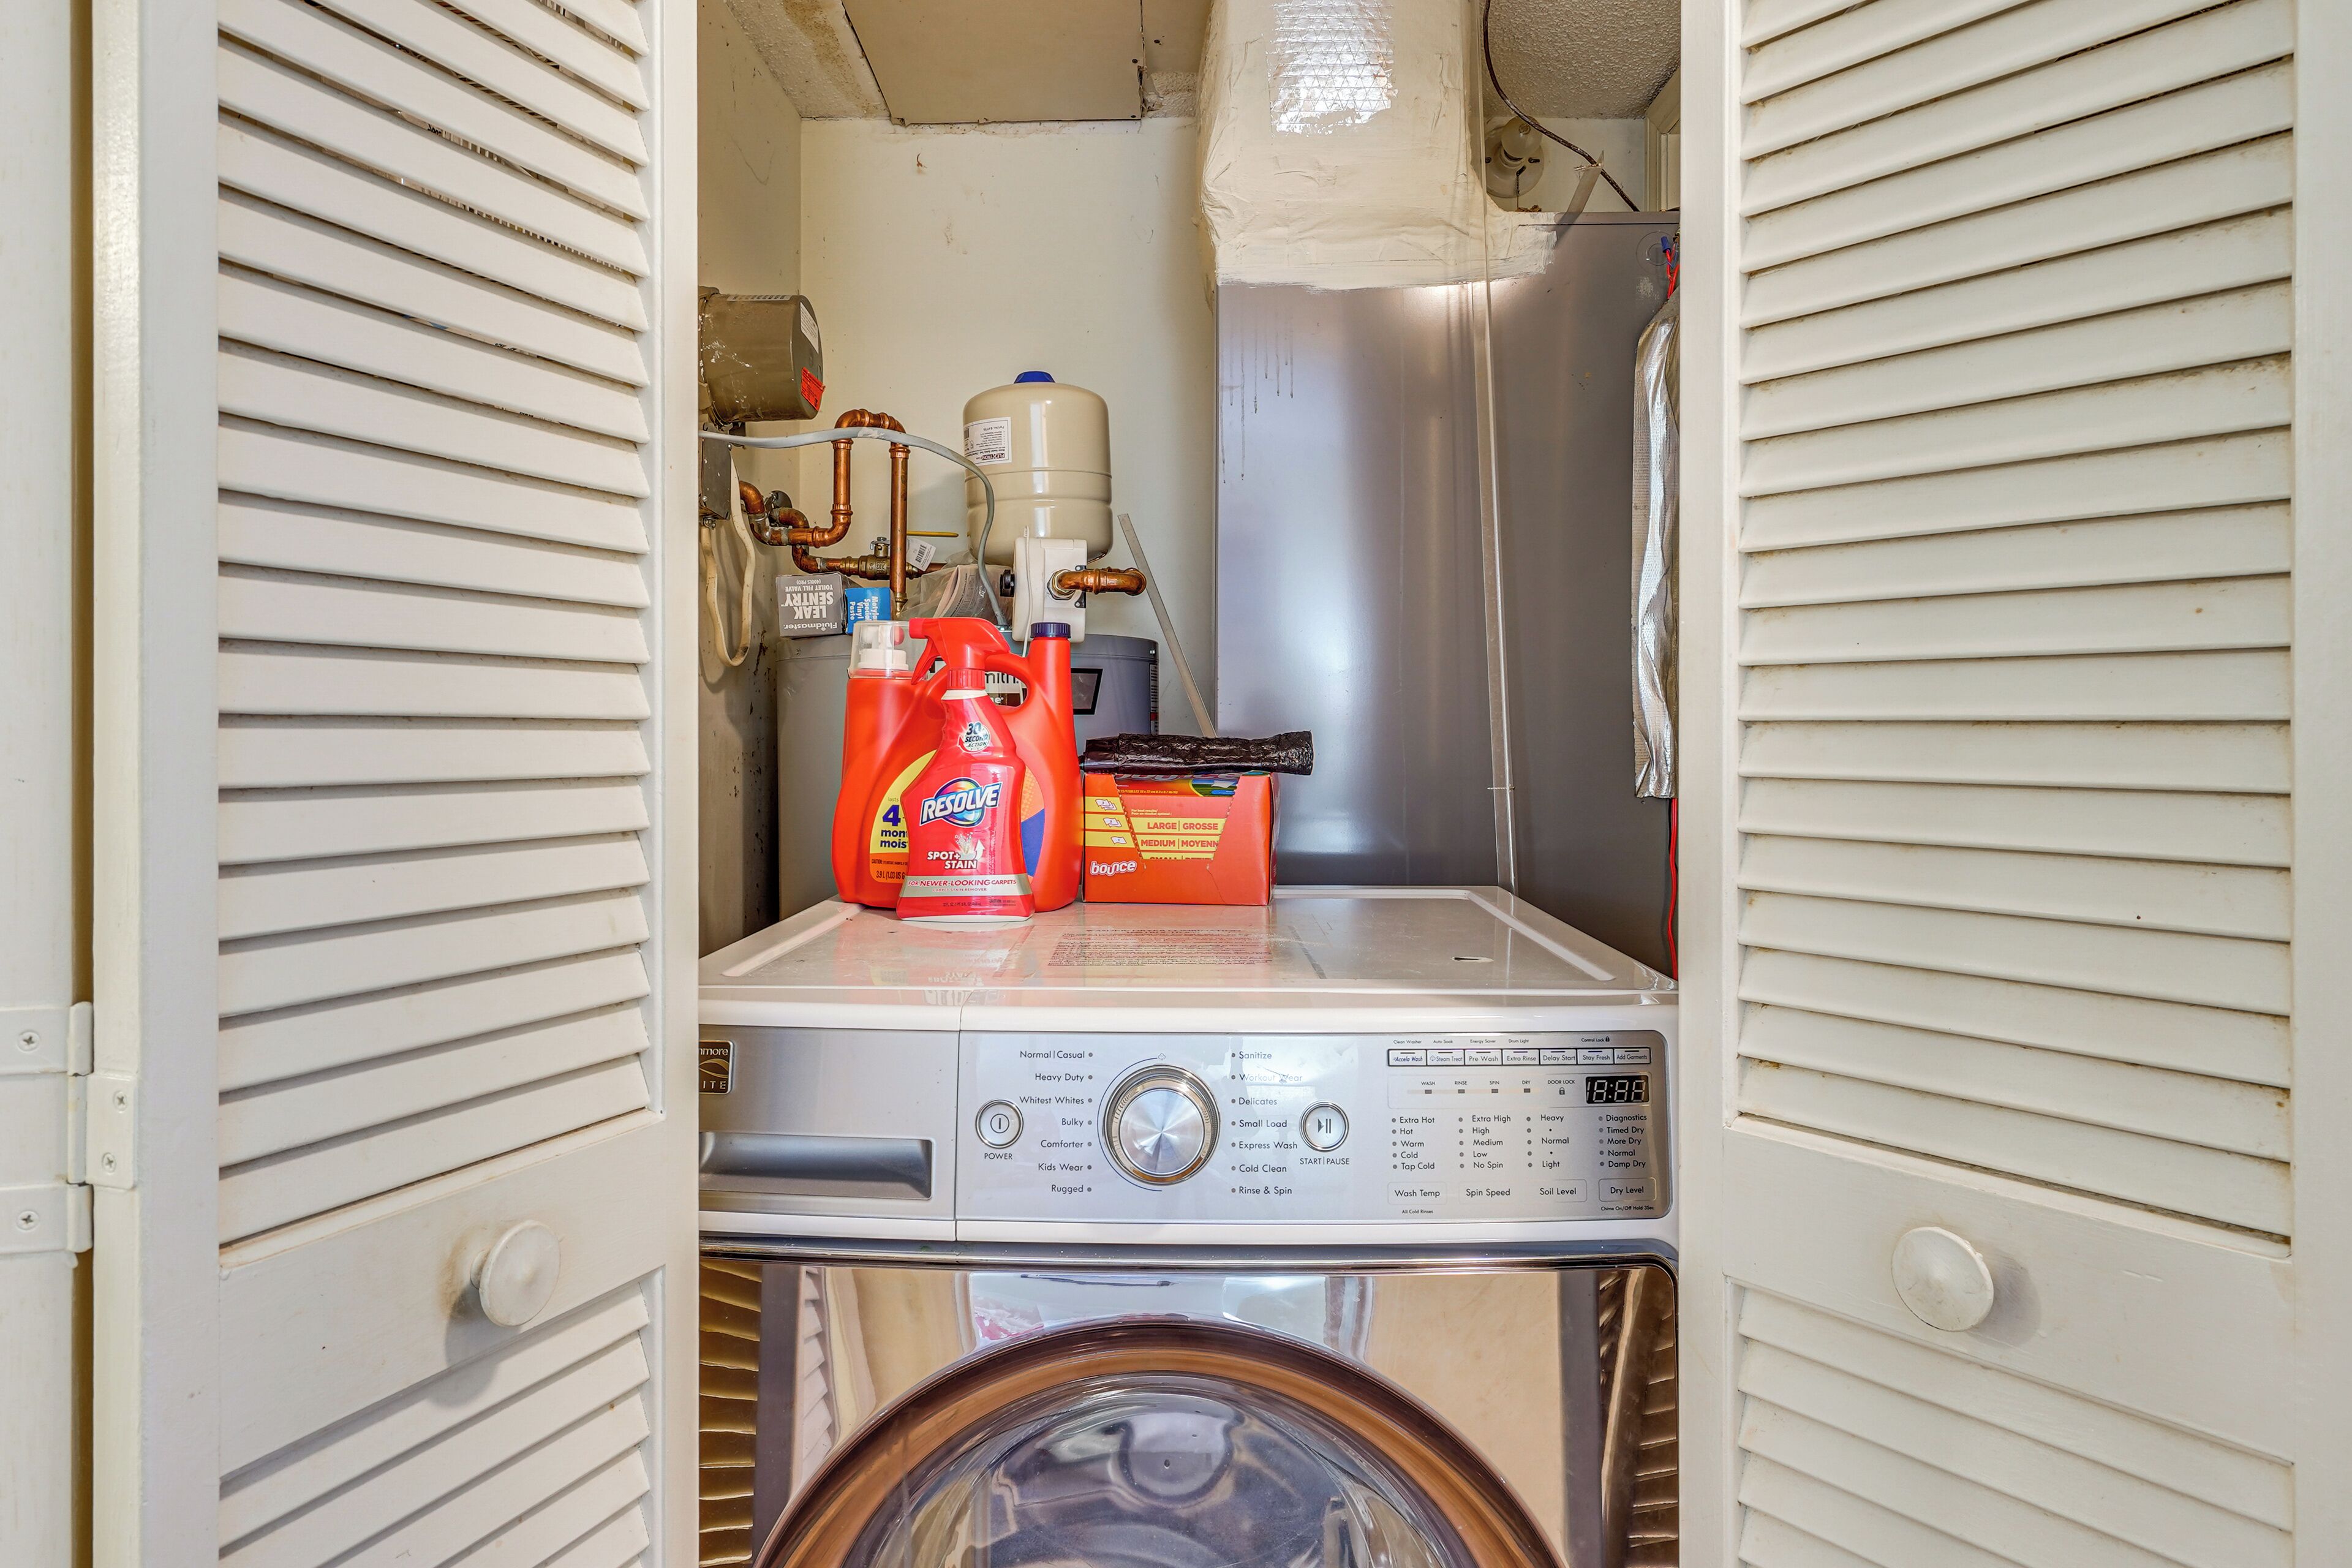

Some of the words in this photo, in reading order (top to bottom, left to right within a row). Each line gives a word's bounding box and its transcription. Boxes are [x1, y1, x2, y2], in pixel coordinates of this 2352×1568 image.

[793, 605, 827, 619] LEAK
[856, 601, 864, 619] Vinyl
[966, 722, 981, 735] 30
[965, 734, 988, 742] SECOND
[921, 784, 1000, 823] RESOLVE
[927, 851, 962, 861] SPOT+
[944, 860, 978, 869] STAIN
[1090, 860, 1137, 876] bounce
[1238, 1050, 1272, 1060] Sanitize
[1543, 1054, 1559, 1063] Delay
[1035, 1072, 1062, 1082] Heavy
[1065, 1073, 1084, 1083] Duty
[1238, 1073, 1275, 1082] Workout
[1278, 1073, 1303, 1082] Wear
[1019, 1096, 1052, 1104] Whitest
[1054, 1096, 1084, 1104] Whites
[1238, 1096, 1277, 1106] Delicates
[1061, 1117, 1084, 1128] Bulky
[1239, 1119, 1263, 1128] Small
[1266, 1119, 1287, 1128] Load
[1494, 1114, 1511, 1124] High
[1540, 1114, 1564, 1123] Heavy
[1606, 1114, 1648, 1123] Diagnostics
[1472, 1126, 1490, 1136] High
[1631, 1126, 1645, 1135] Dry
[1040, 1139, 1084, 1148] Comforter
[1238, 1140, 1270, 1151] Express
[1273, 1141, 1298, 1150] Wash
[1628, 1137, 1642, 1146] Dry
[1608, 1148, 1635, 1157] Normal
[1038, 1163, 1056, 1171] Kids
[1239, 1164, 1259, 1172] Cold
[1262, 1164, 1287, 1172] Clean
[1401, 1162, 1415, 1172] Tap
[1487, 1161, 1504, 1170] Spin
[1542, 1160, 1560, 1169] Light
[1608, 1160, 1630, 1169] Damp
[1633, 1159, 1646, 1169] Dry
[1051, 1184, 1084, 1194] Rugged
[1239, 1186, 1261, 1194] Rinse
[1263, 1186, 1270, 1194] &
[1273, 1186, 1292, 1196] Spin
[1419, 1189, 1441, 1199] Temp
[1466, 1188, 1483, 1198] Spin
[1485, 1188, 1510, 1198] Speed
[1540, 1187, 1554, 1196] Soil
[1610, 1186, 1624, 1196] Dry
